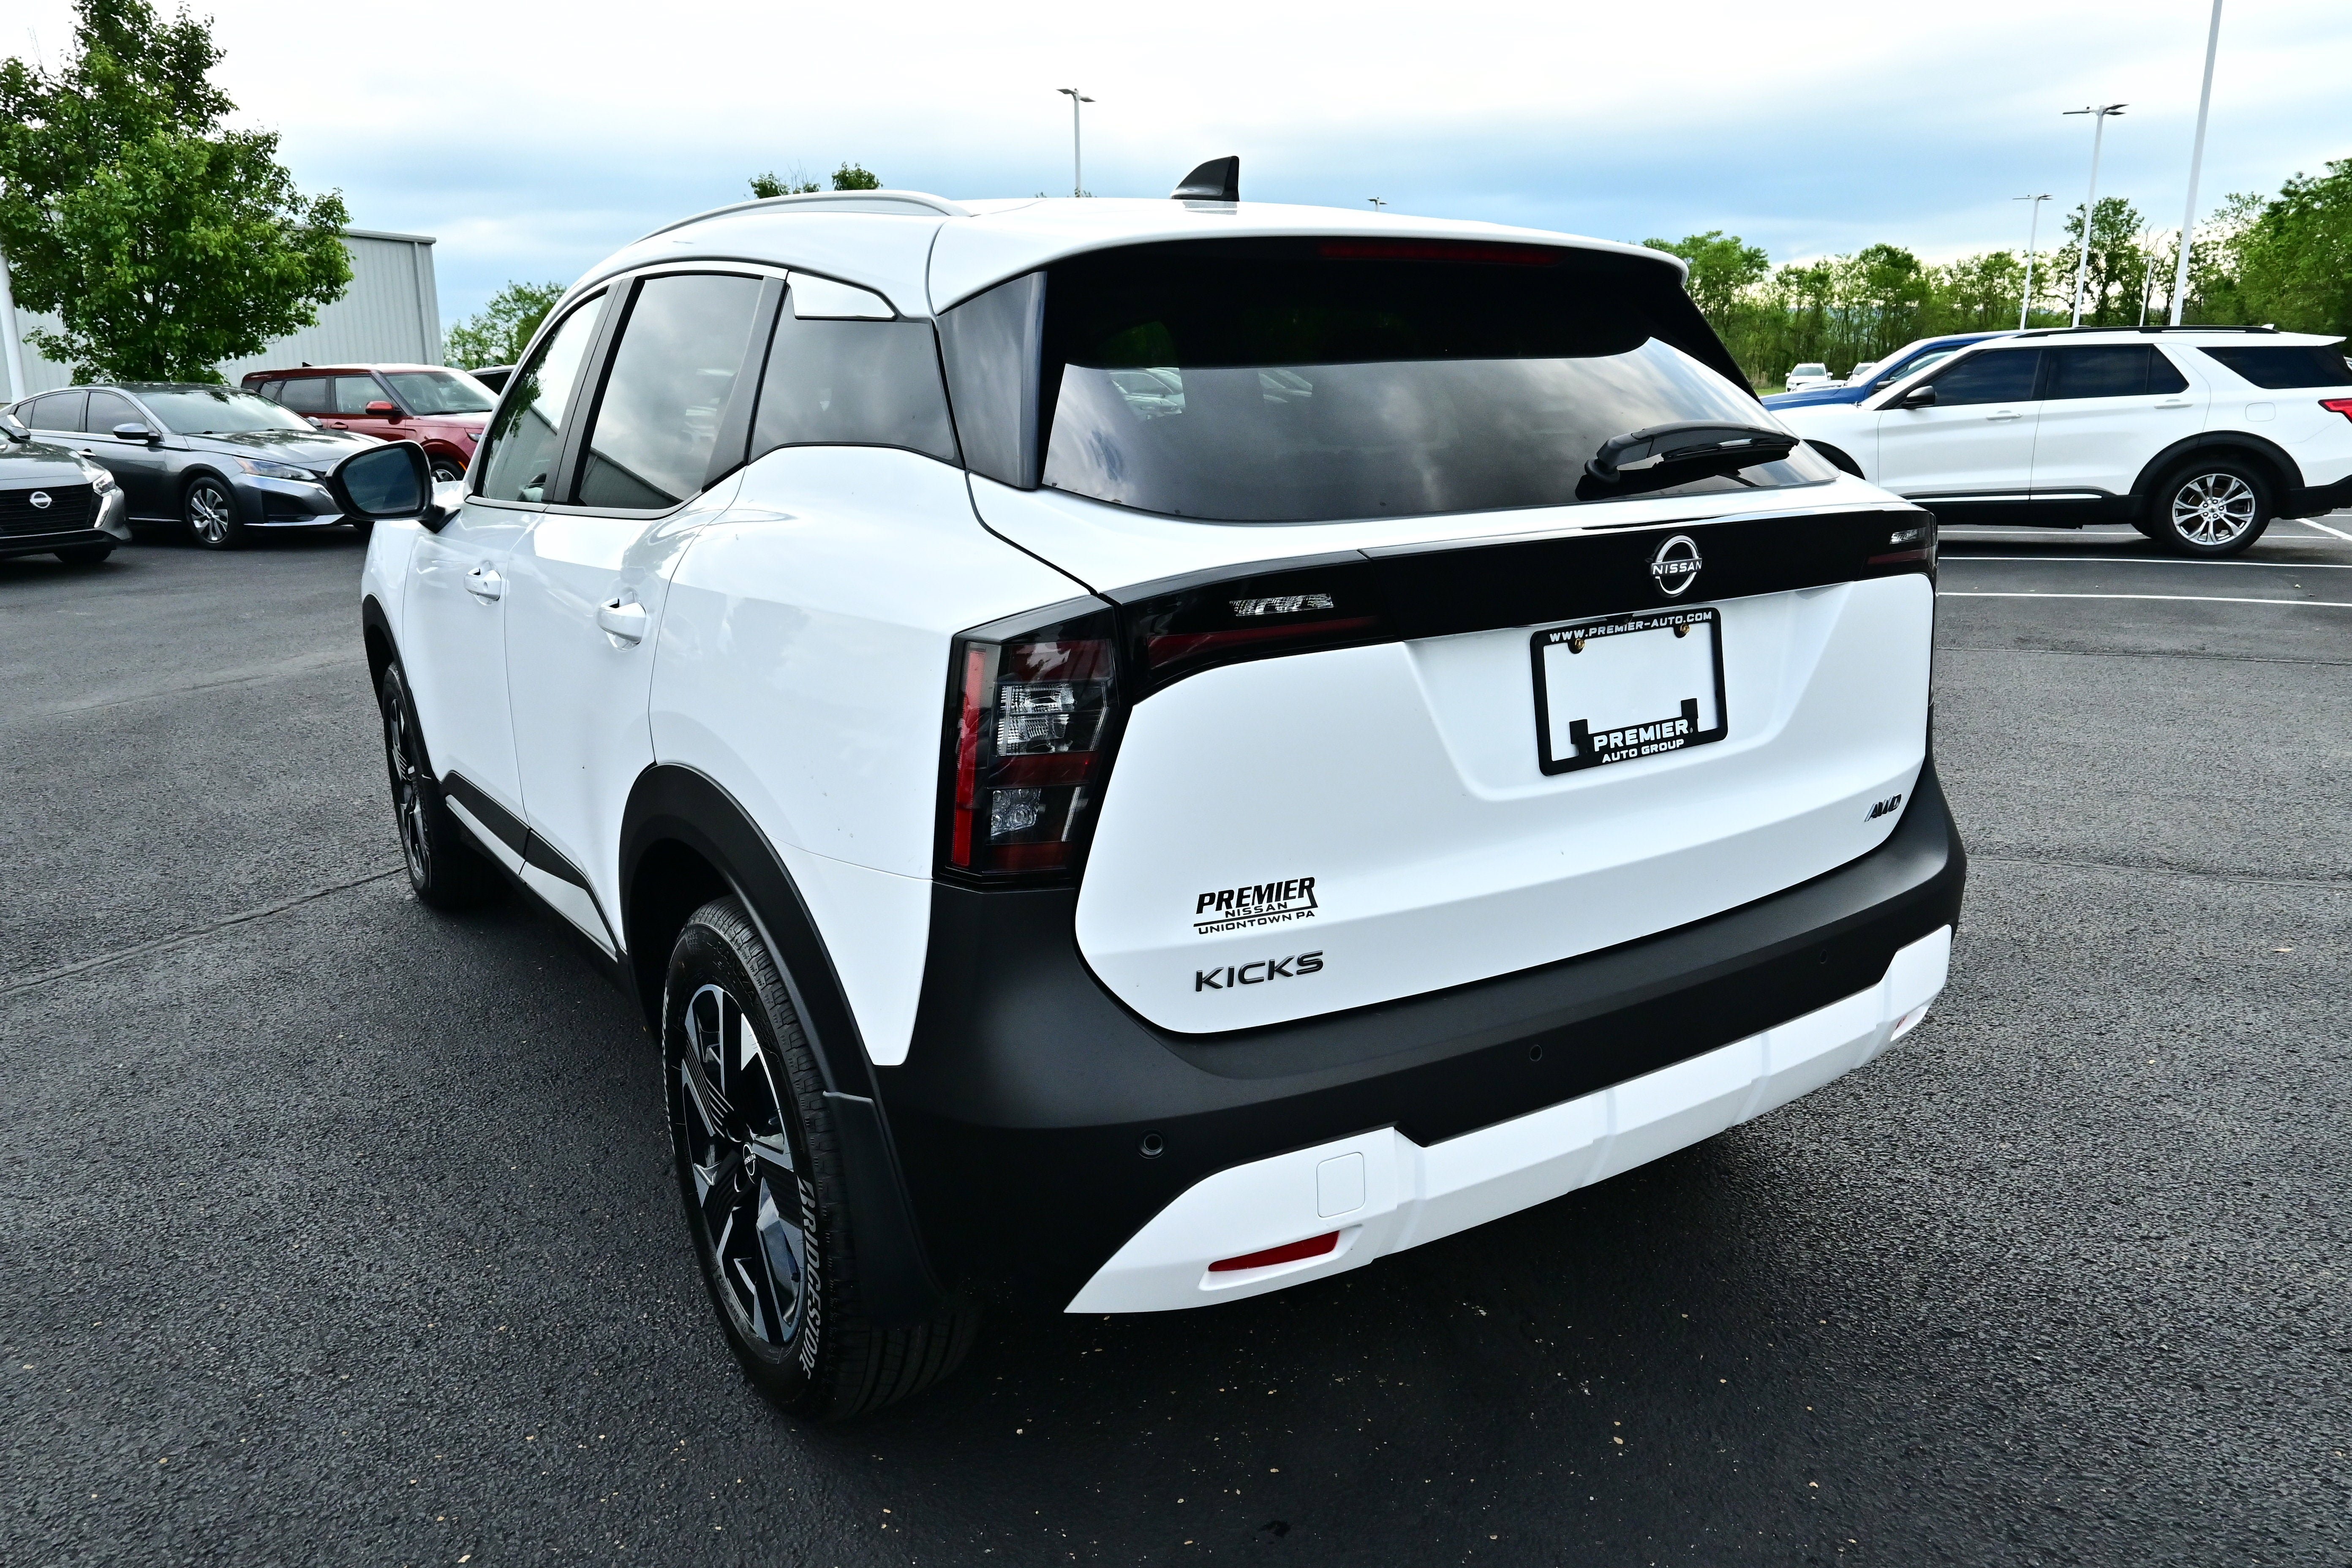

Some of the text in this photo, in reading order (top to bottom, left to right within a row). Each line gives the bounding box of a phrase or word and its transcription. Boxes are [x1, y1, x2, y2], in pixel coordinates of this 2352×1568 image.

[1652, 560, 1702, 575] NISSAN
[1550, 611, 1712, 642] WWW.PREMIER-AUTO.COM
[1593, 719, 1689, 752] PREMIER
[1602, 739, 1684, 763] AUTO GROUP
[1864, 794, 1902, 822] AWD
[1196, 877, 1318, 915] PREMIER
[1225, 902, 1288, 918] NISSAN
[1198, 910, 1315, 934] UNIONTOWN PA
[1195, 950, 1324, 992] KICKS
[744, 1153, 756, 1165] NISS
[796, 1175, 821, 1380] BRIDGESTONE
